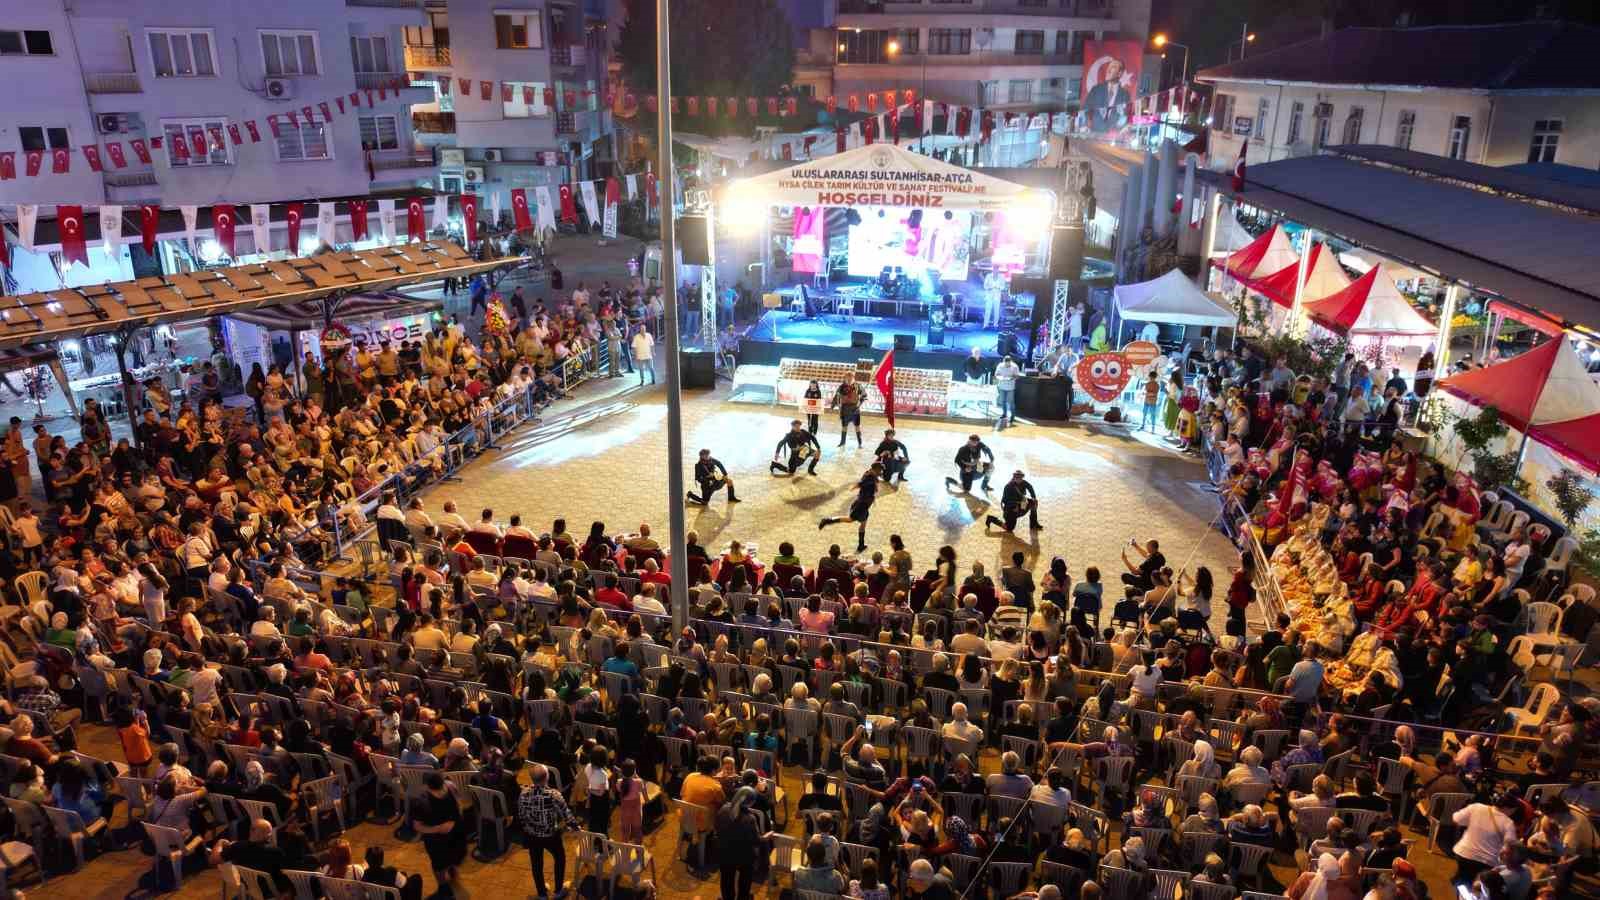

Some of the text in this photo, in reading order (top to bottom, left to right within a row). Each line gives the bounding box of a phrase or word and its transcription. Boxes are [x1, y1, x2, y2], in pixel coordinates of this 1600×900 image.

[792, 169, 972, 183] ULUSLARARASI SULTANHİSAR-ATÇA
[802, 180, 825, 189] ÇİLEK
[826, 181, 852, 190] TARIM
[853, 181, 884, 190] KÜLTÜR
[886, 182, 897, 191] VE
[898, 183, 926, 192] SANAT
[818, 191, 943, 207] HOŞGELDİNİZ
